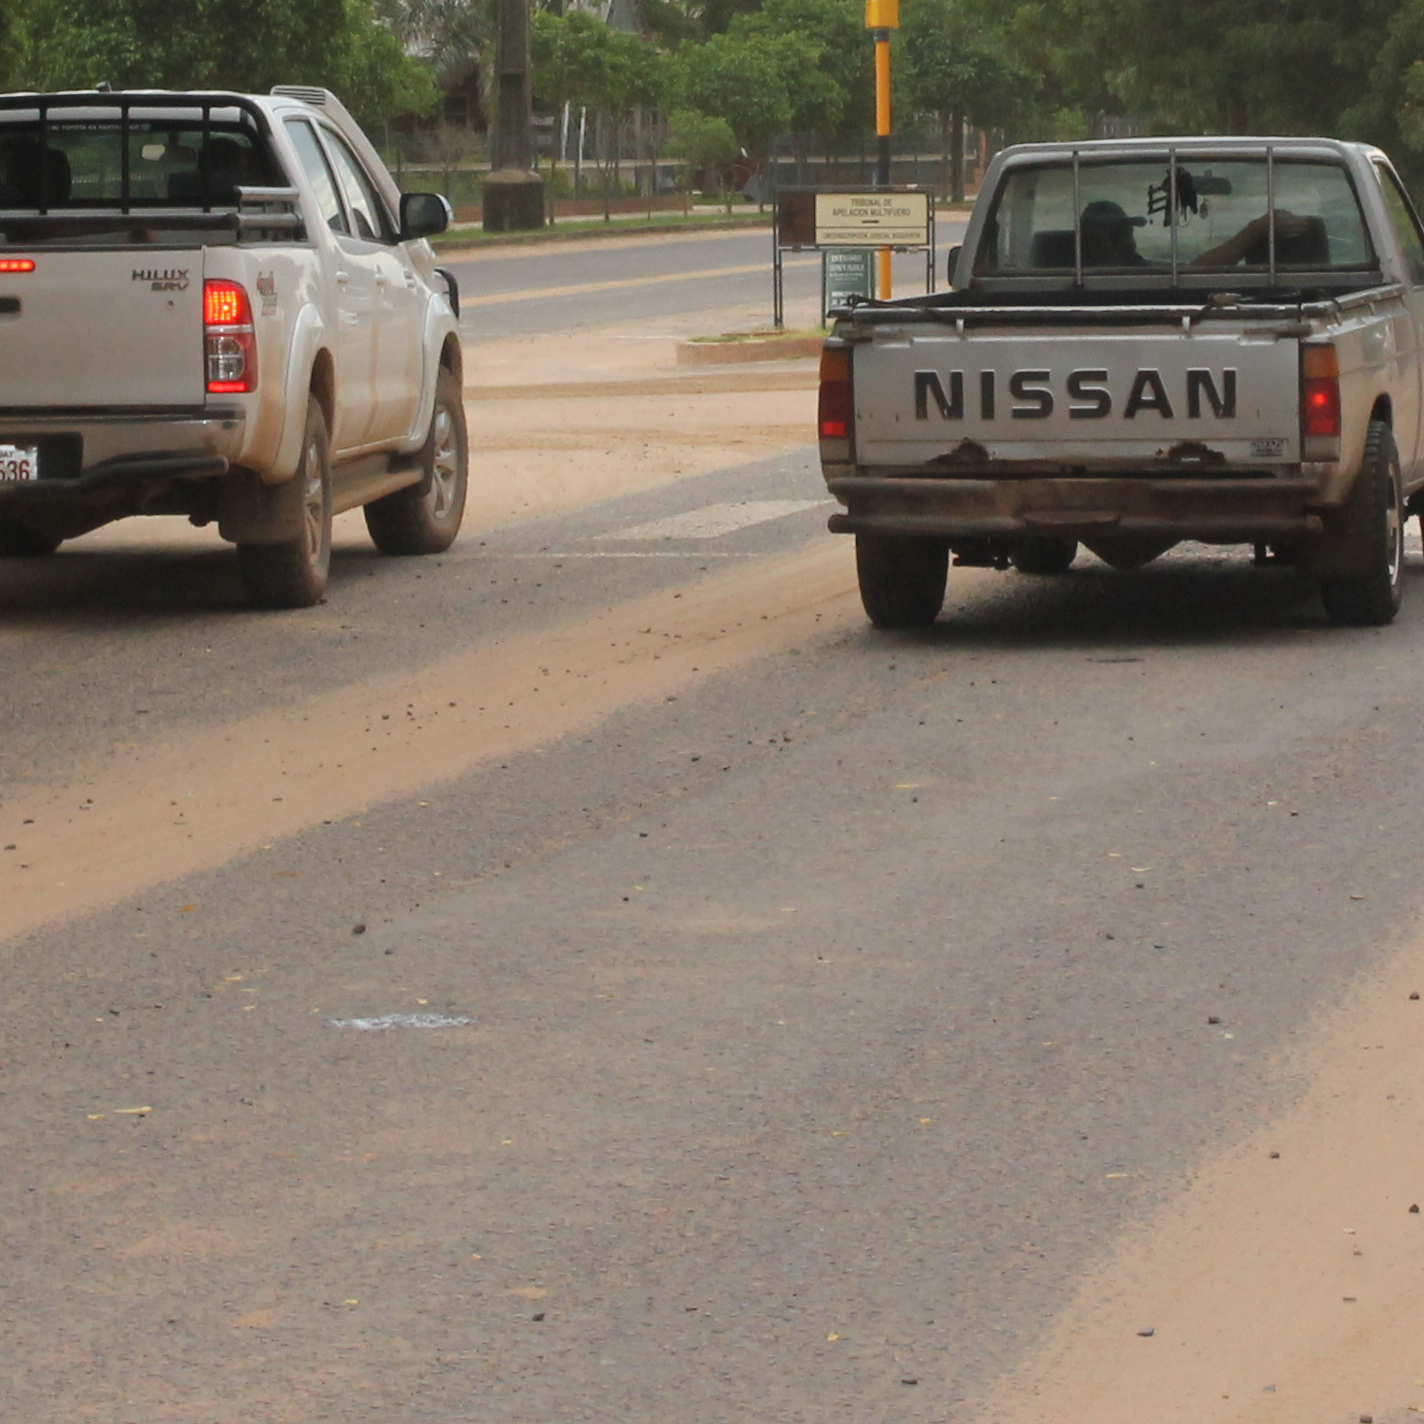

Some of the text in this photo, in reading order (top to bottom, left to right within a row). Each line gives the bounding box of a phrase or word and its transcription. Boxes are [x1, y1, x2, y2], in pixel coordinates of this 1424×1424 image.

[851, 198, 892, 206] TRIBUNAL DE
[132, 269, 189, 281] HILUX
[914, 366, 1238, 421] NISSAN
